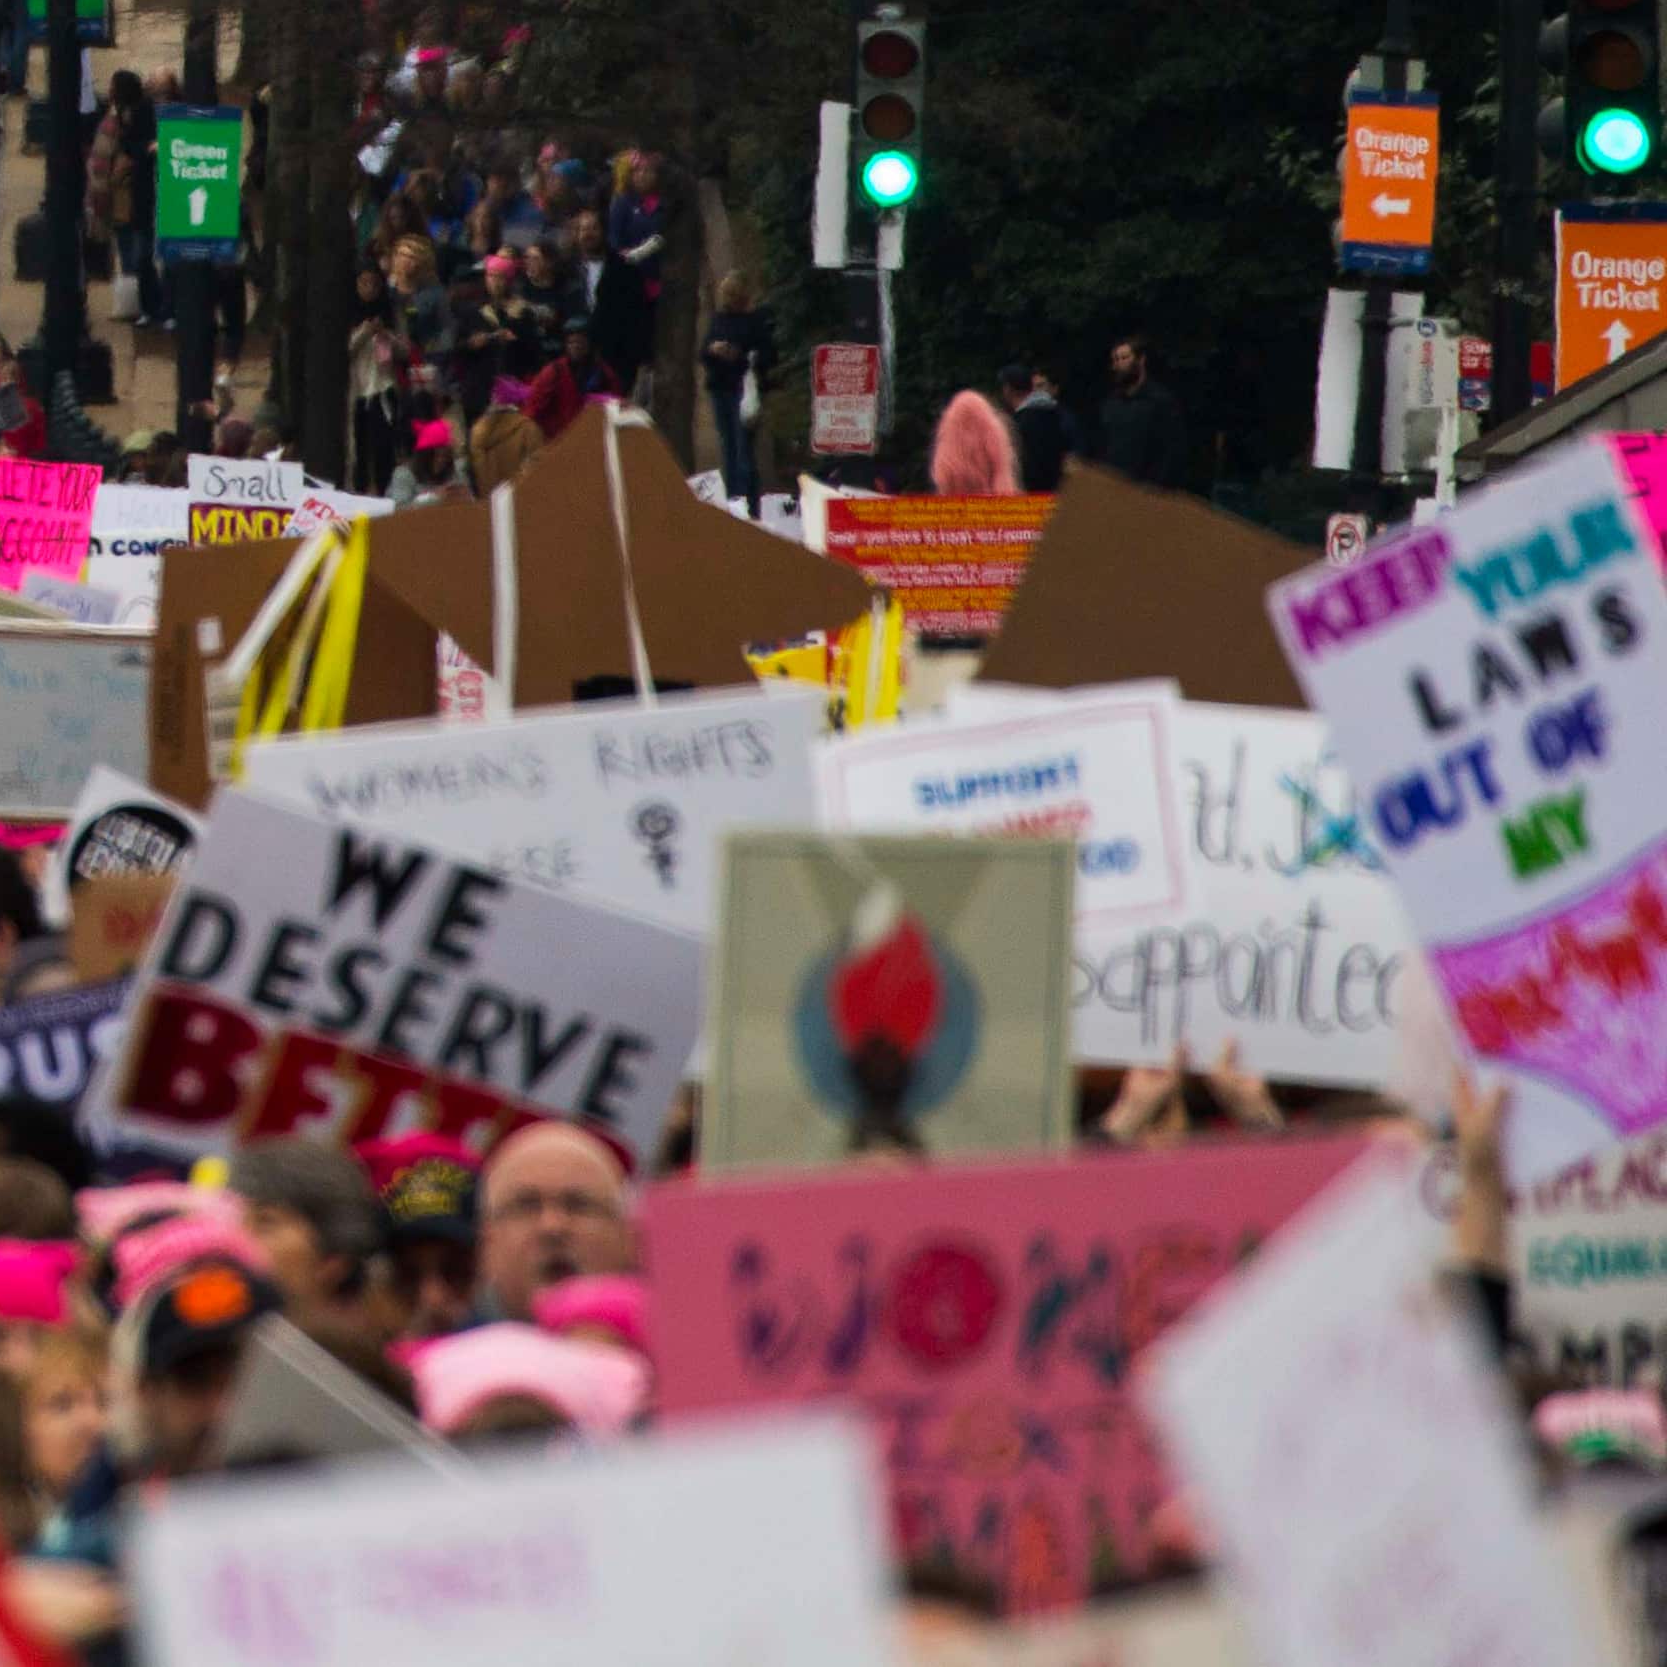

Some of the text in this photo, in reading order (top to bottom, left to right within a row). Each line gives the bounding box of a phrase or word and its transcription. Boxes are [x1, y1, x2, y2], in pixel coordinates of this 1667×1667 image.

[170, 138, 228, 161] Green
[1355, 127, 1430, 157] Orange
[170, 160, 228, 181] Ticket
[1359, 152, 1426, 180] Ticket
[1570, 250, 1666, 284] Orange
[1578, 282, 1660, 311] Ticket
[55, 464, 98, 512] YOUR
[203, 464, 289, 503] Small
[1405, 584, 1640, 734] LAWS
[1372, 737, 1502, 852] OUT
[1524, 689, 1607, 772] OF
[1498, 786, 1593, 881] MY
[325, 824, 512, 968] WE
[160, 889, 657, 1126] DESERVE
